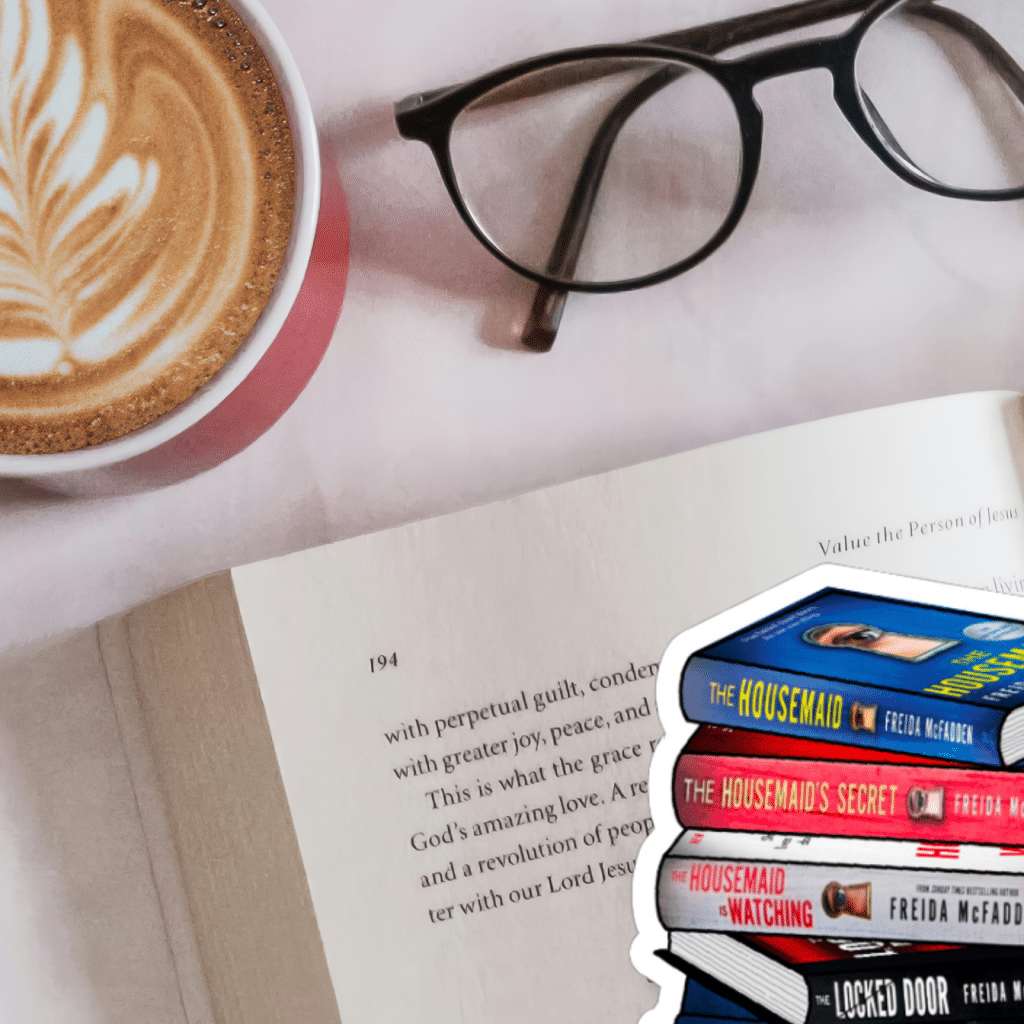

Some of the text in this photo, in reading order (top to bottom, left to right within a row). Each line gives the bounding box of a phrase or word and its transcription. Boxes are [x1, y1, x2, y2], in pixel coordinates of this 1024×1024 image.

[818, 507, 1019, 556] Value the Person of Jesus
[369, 652, 399, 673] 194
[710, 678, 973, 745] THE HOUSEMAID FREIDA McFADDEN
[393, 698, 651, 780] with greater joy, peace, and
[684, 778, 715, 804] THE
[721, 776, 829, 813] HOUSEMAID'S
[837, 783, 898, 815] SECRET
[953, 793, 1002, 817] FREIDA
[671, 863, 786, 895] THE HOUSEMAID
[719, 896, 814, 929] IS WATCHING
[890, 896, 948, 922] FREIDA
[815, 995, 830, 1006] THE
[834, 977, 897, 1019] LOCKED
[903, 975, 949, 1017] DOOR
[963, 981, 1007, 1004] FREIDA
